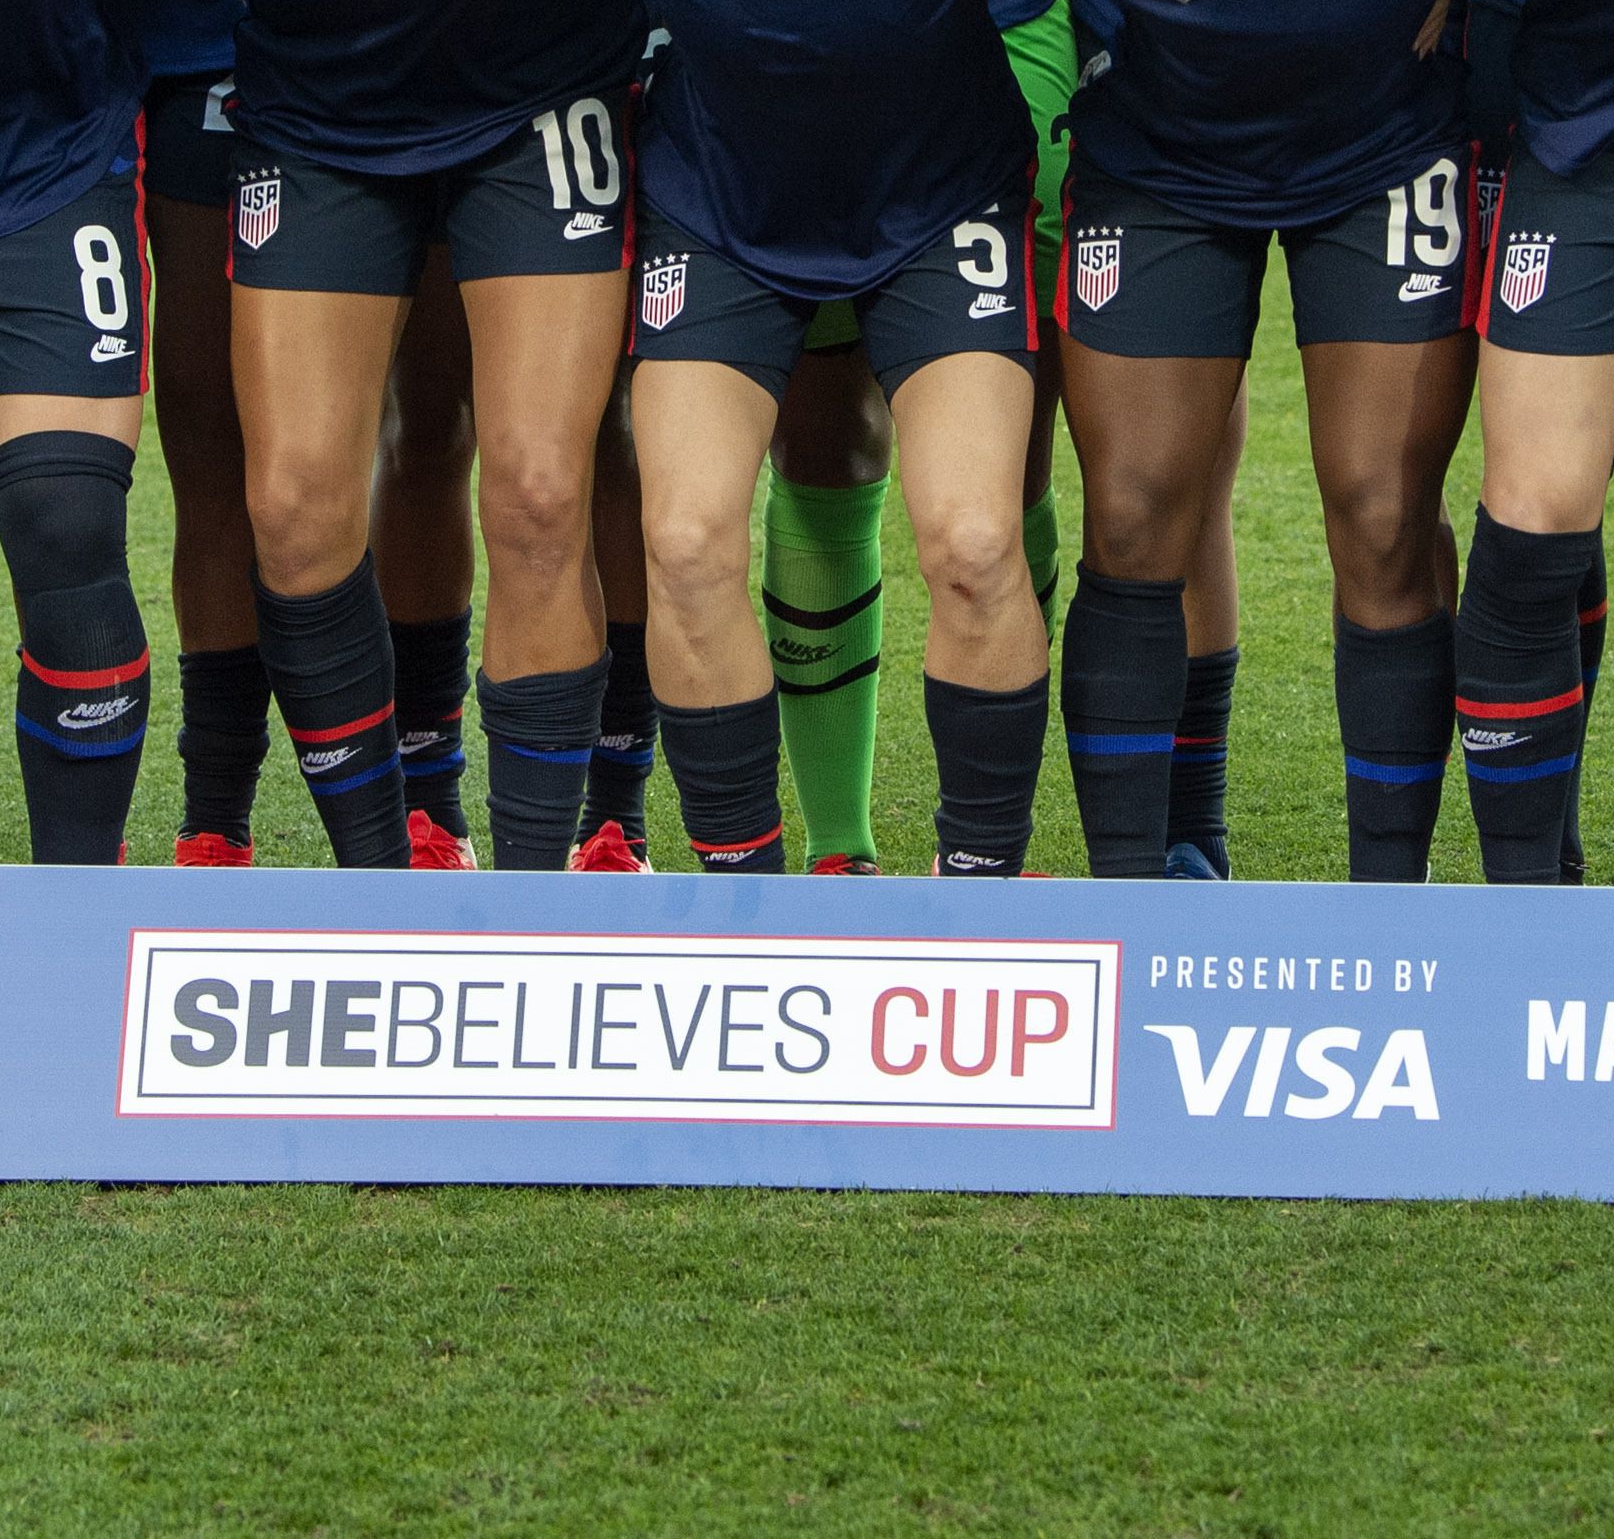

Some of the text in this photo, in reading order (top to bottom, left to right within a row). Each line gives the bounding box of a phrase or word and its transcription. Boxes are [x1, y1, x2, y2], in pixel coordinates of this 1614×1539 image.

[532, 98, 620, 209] 10
[243, 185, 278, 211] USA
[572, 211, 605, 230] NIKE
[1387, 158, 1461, 267] 19
[1079, 245, 1117, 271] USA
[1507, 248, 1546, 273] USA
[74, 225, 129, 331] 8
[645, 267, 684, 295] USA
[1406, 272, 1443, 291] NIKE
[976, 292, 1008, 309] NIKE
[98, 334, 128, 353] NIKE
[1150, 955, 1438, 993] PRESENTED BY
[169, 977, 1071, 1079] SHEBELIEVES CUP
[1142, 1024, 1441, 1121] VISA
